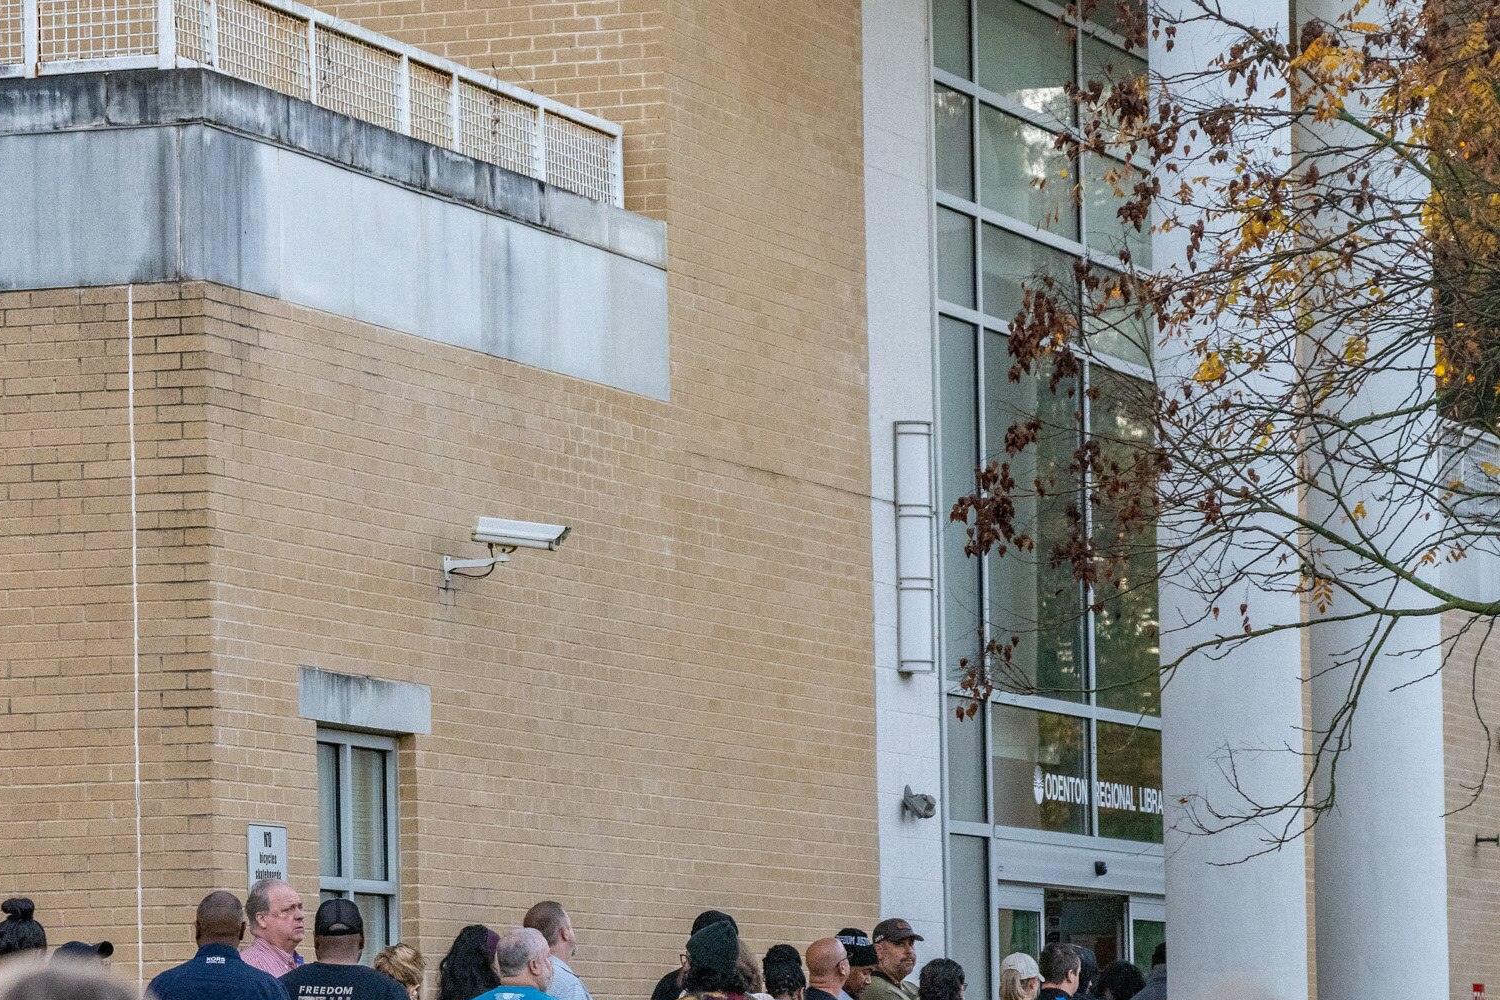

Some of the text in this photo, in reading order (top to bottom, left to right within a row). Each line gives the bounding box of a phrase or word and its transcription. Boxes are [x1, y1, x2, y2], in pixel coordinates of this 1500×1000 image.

[1045, 773, 1163, 815] ODENTON REGIONAL LIBRA
[263, 831, 272, 848] NO
[259, 852, 277, 866] bicycles
[255, 868, 282, 880] skateboards
[298, 985, 353, 996] FREEDOM
